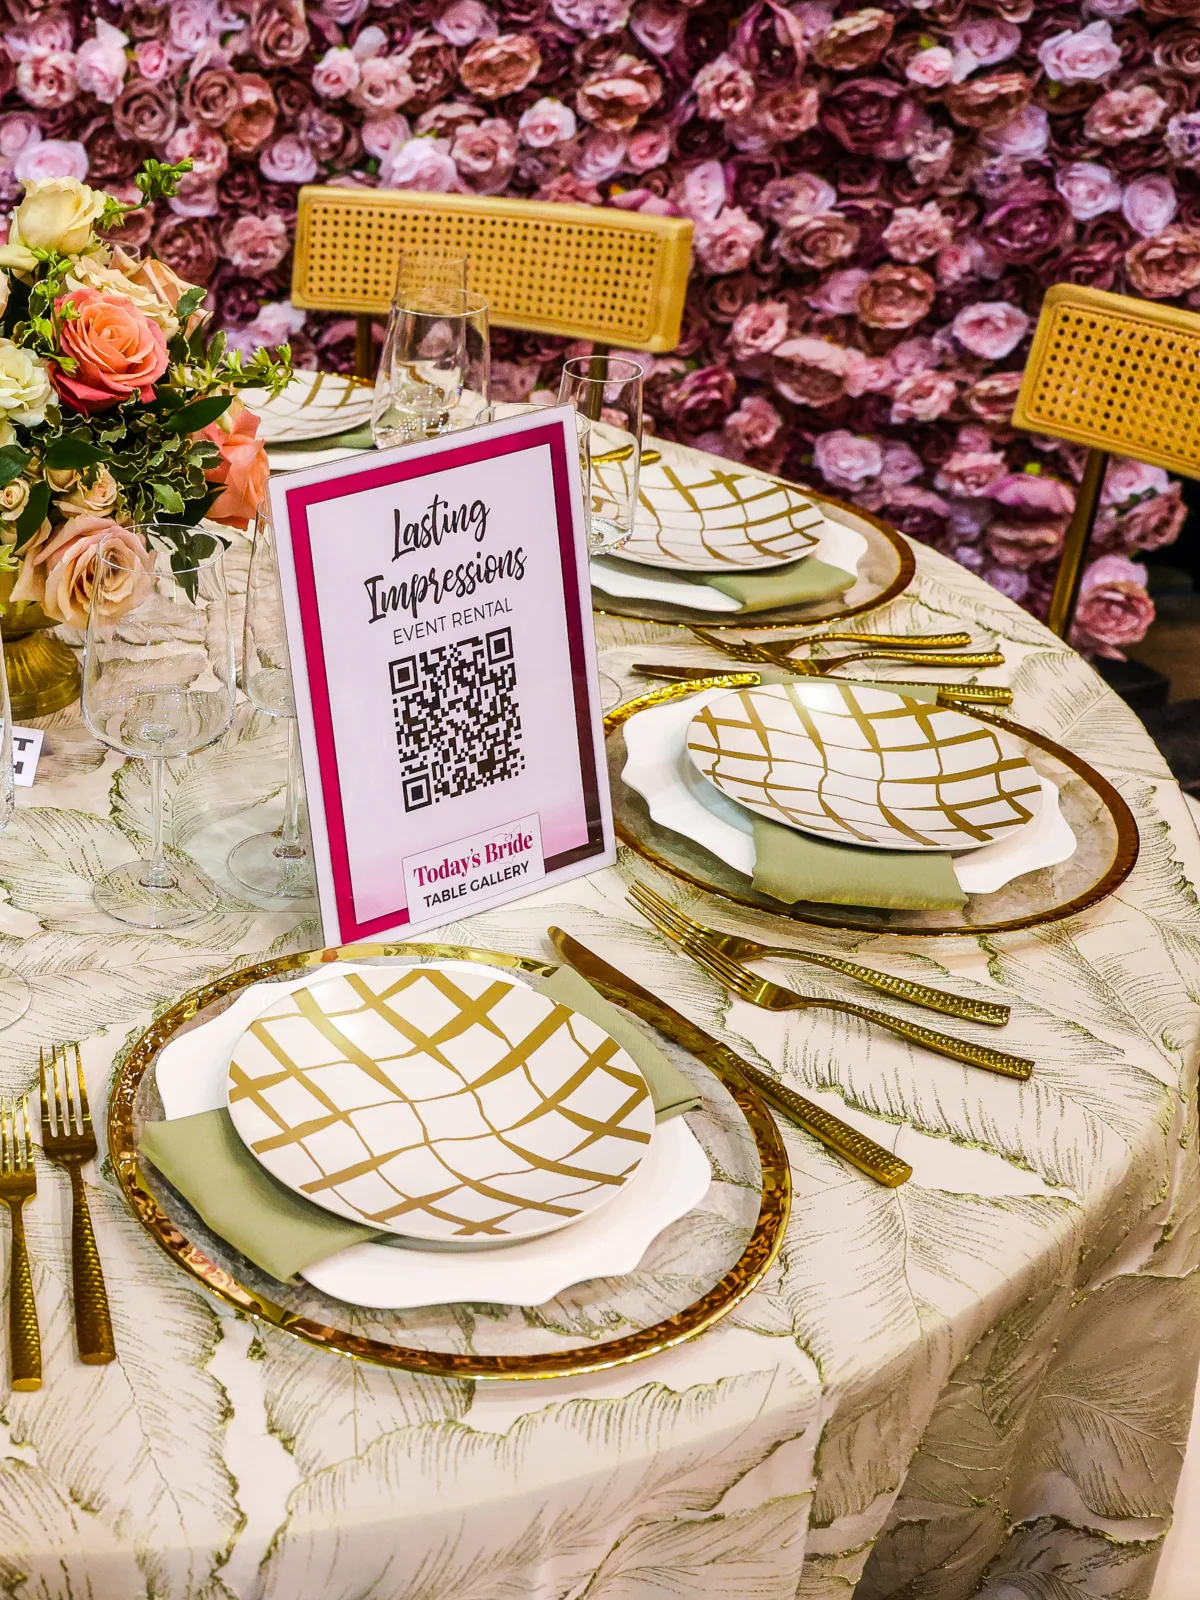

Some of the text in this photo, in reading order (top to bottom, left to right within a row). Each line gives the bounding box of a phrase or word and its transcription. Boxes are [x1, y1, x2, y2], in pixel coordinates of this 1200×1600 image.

[392, 494, 490, 562] Lasting
[364, 547, 527, 624] Impressions
[393, 598, 513, 645] EVENT RENTAL
[413, 832, 534, 887] Today's Bride
[423, 861, 529, 908] TABLE GALLERY
